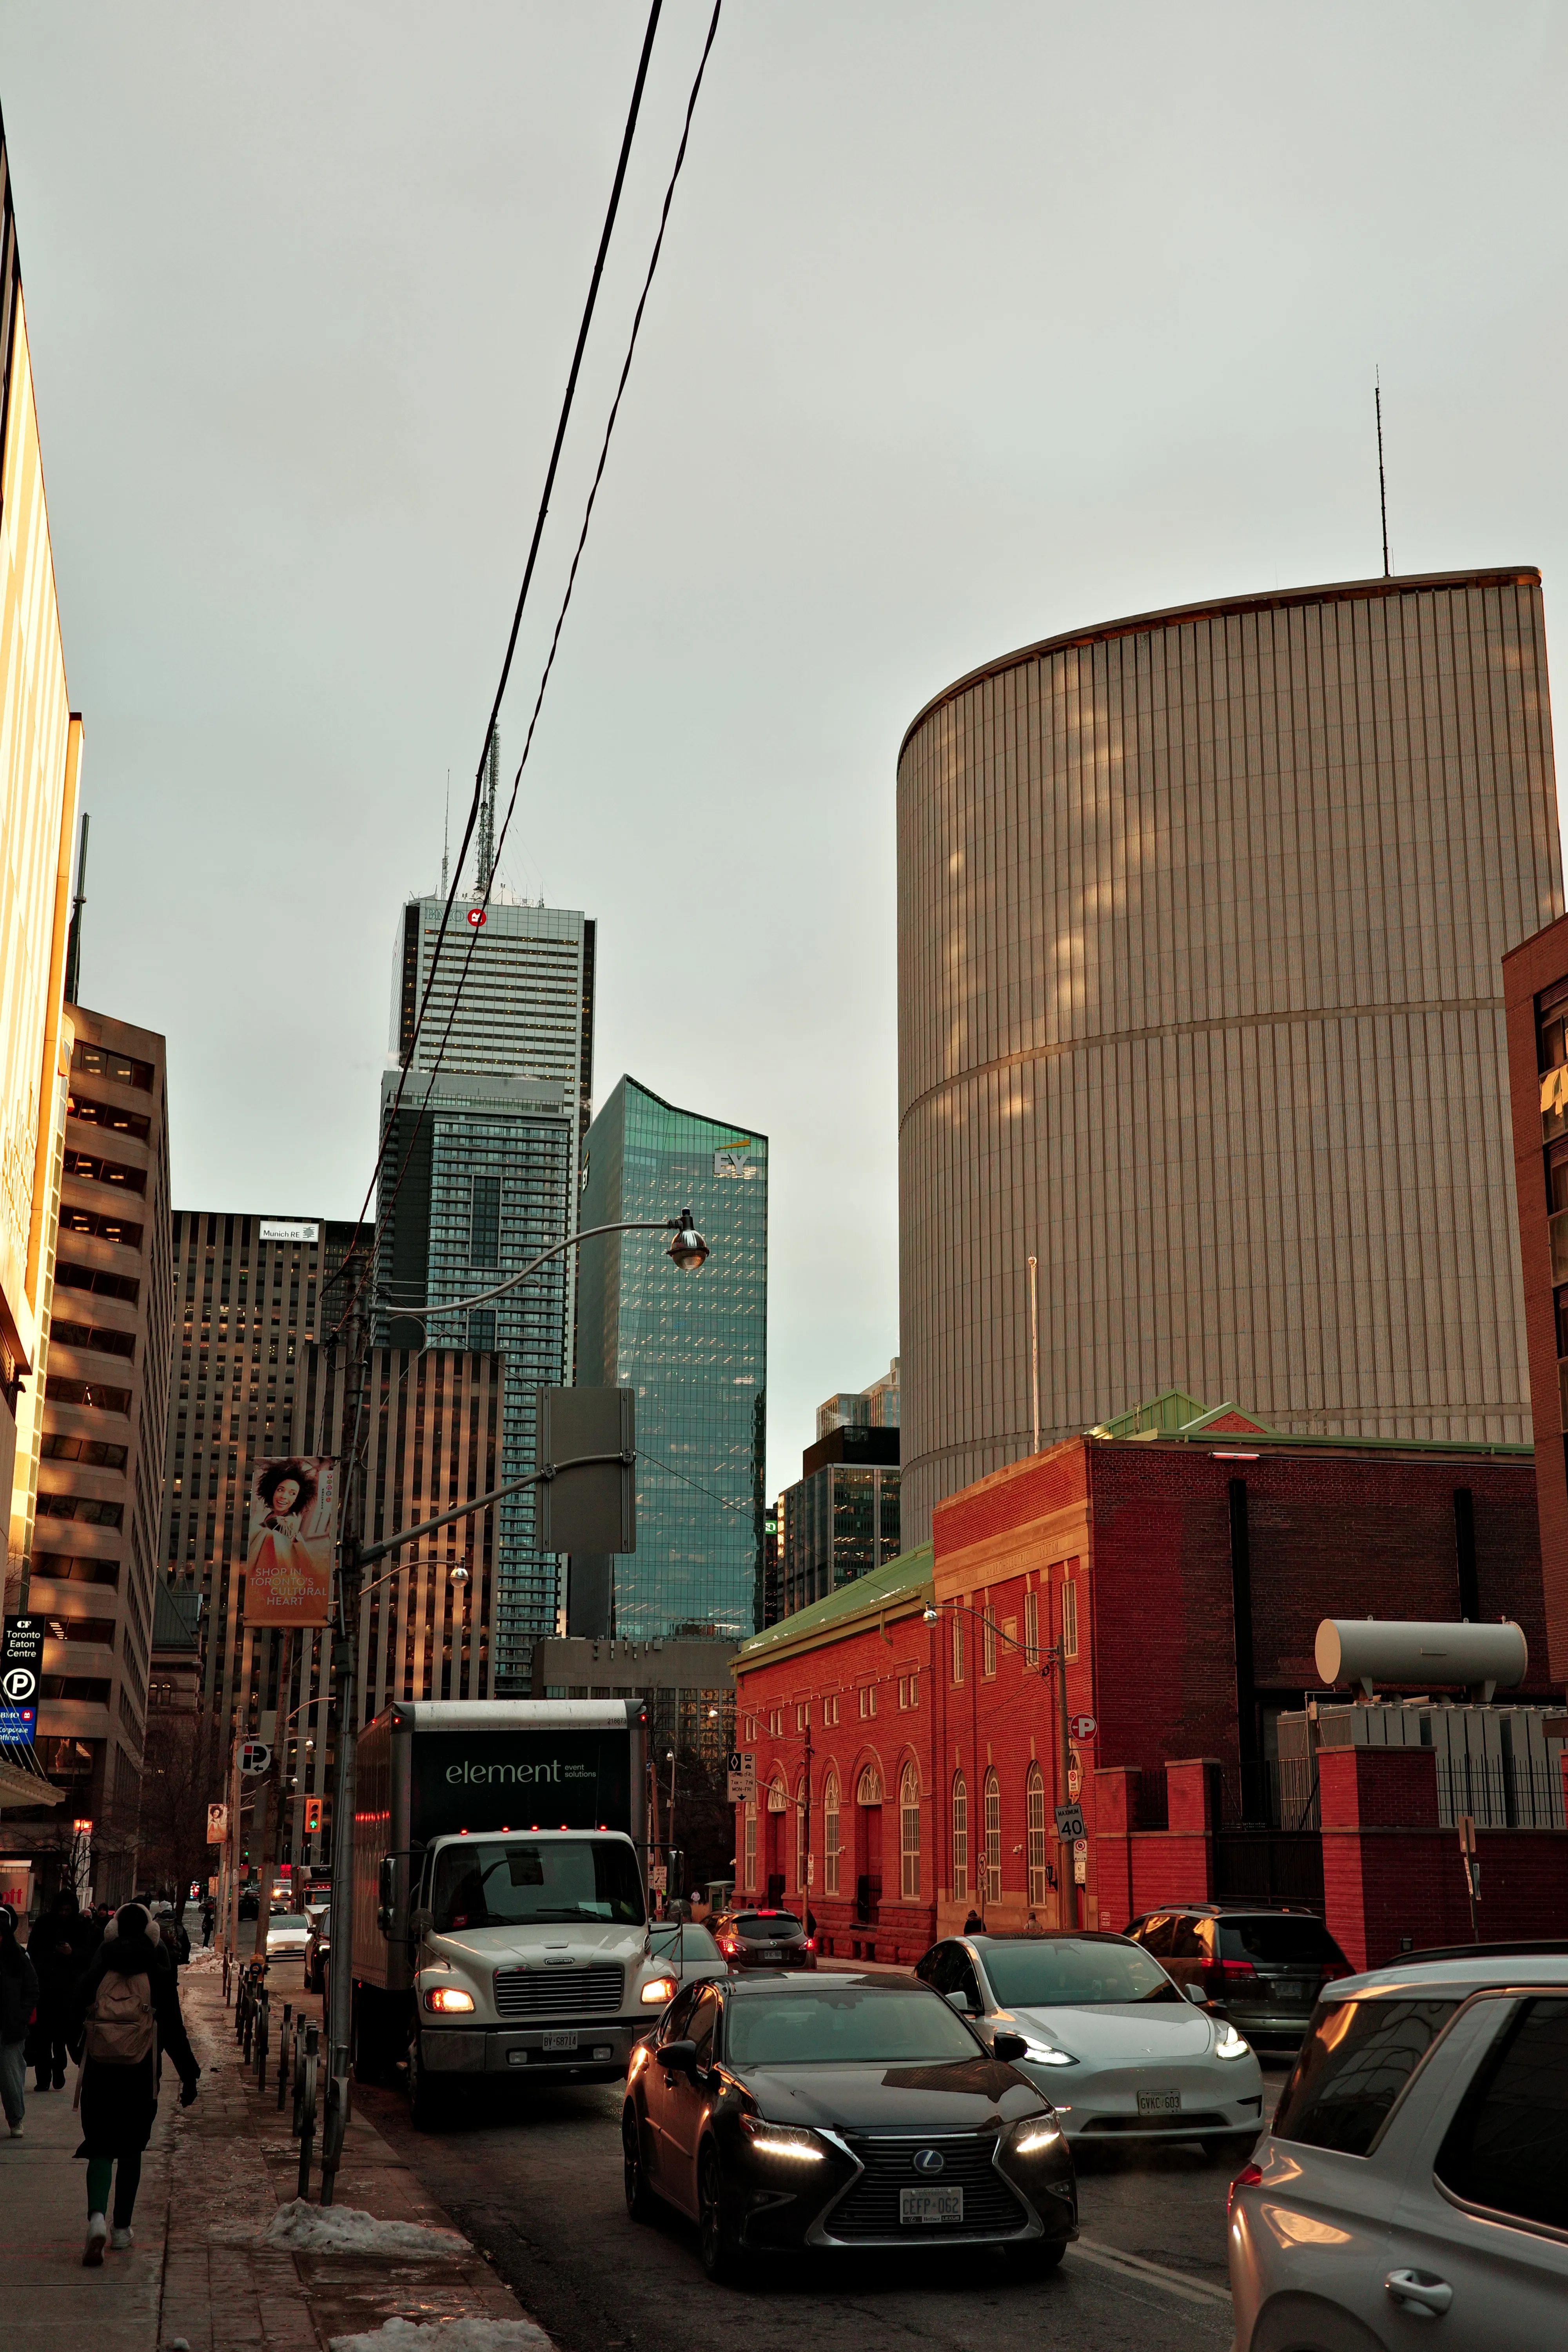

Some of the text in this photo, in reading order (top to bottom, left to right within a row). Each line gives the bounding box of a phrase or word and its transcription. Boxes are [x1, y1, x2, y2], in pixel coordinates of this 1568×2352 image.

[714, 1152, 749, 1175] EY
[1039, 1541, 1059, 1558] SYSTEM
[256, 1568, 287, 1576] SHOP
[250, 1577, 314, 1586] TORONTO'S
[270, 1587, 327, 1595] CULTURAL
[267, 1597, 303, 1605] HEART
[6, 1630, 40, 1639] Toronto
[12, 1674, 28, 1694] P
[1078, 1718, 1095, 1737] P
[446, 1760, 561, 1784] element
[1058, 1808, 1079, 1817] MAXIMUM
[1061, 1819, 1082, 1836] 40
[544, 2036, 576, 2046] BV 68714
[1141, 2096, 1179, 2109] GVKC 603
[903, 2197, 959, 2215] CEFP 062
